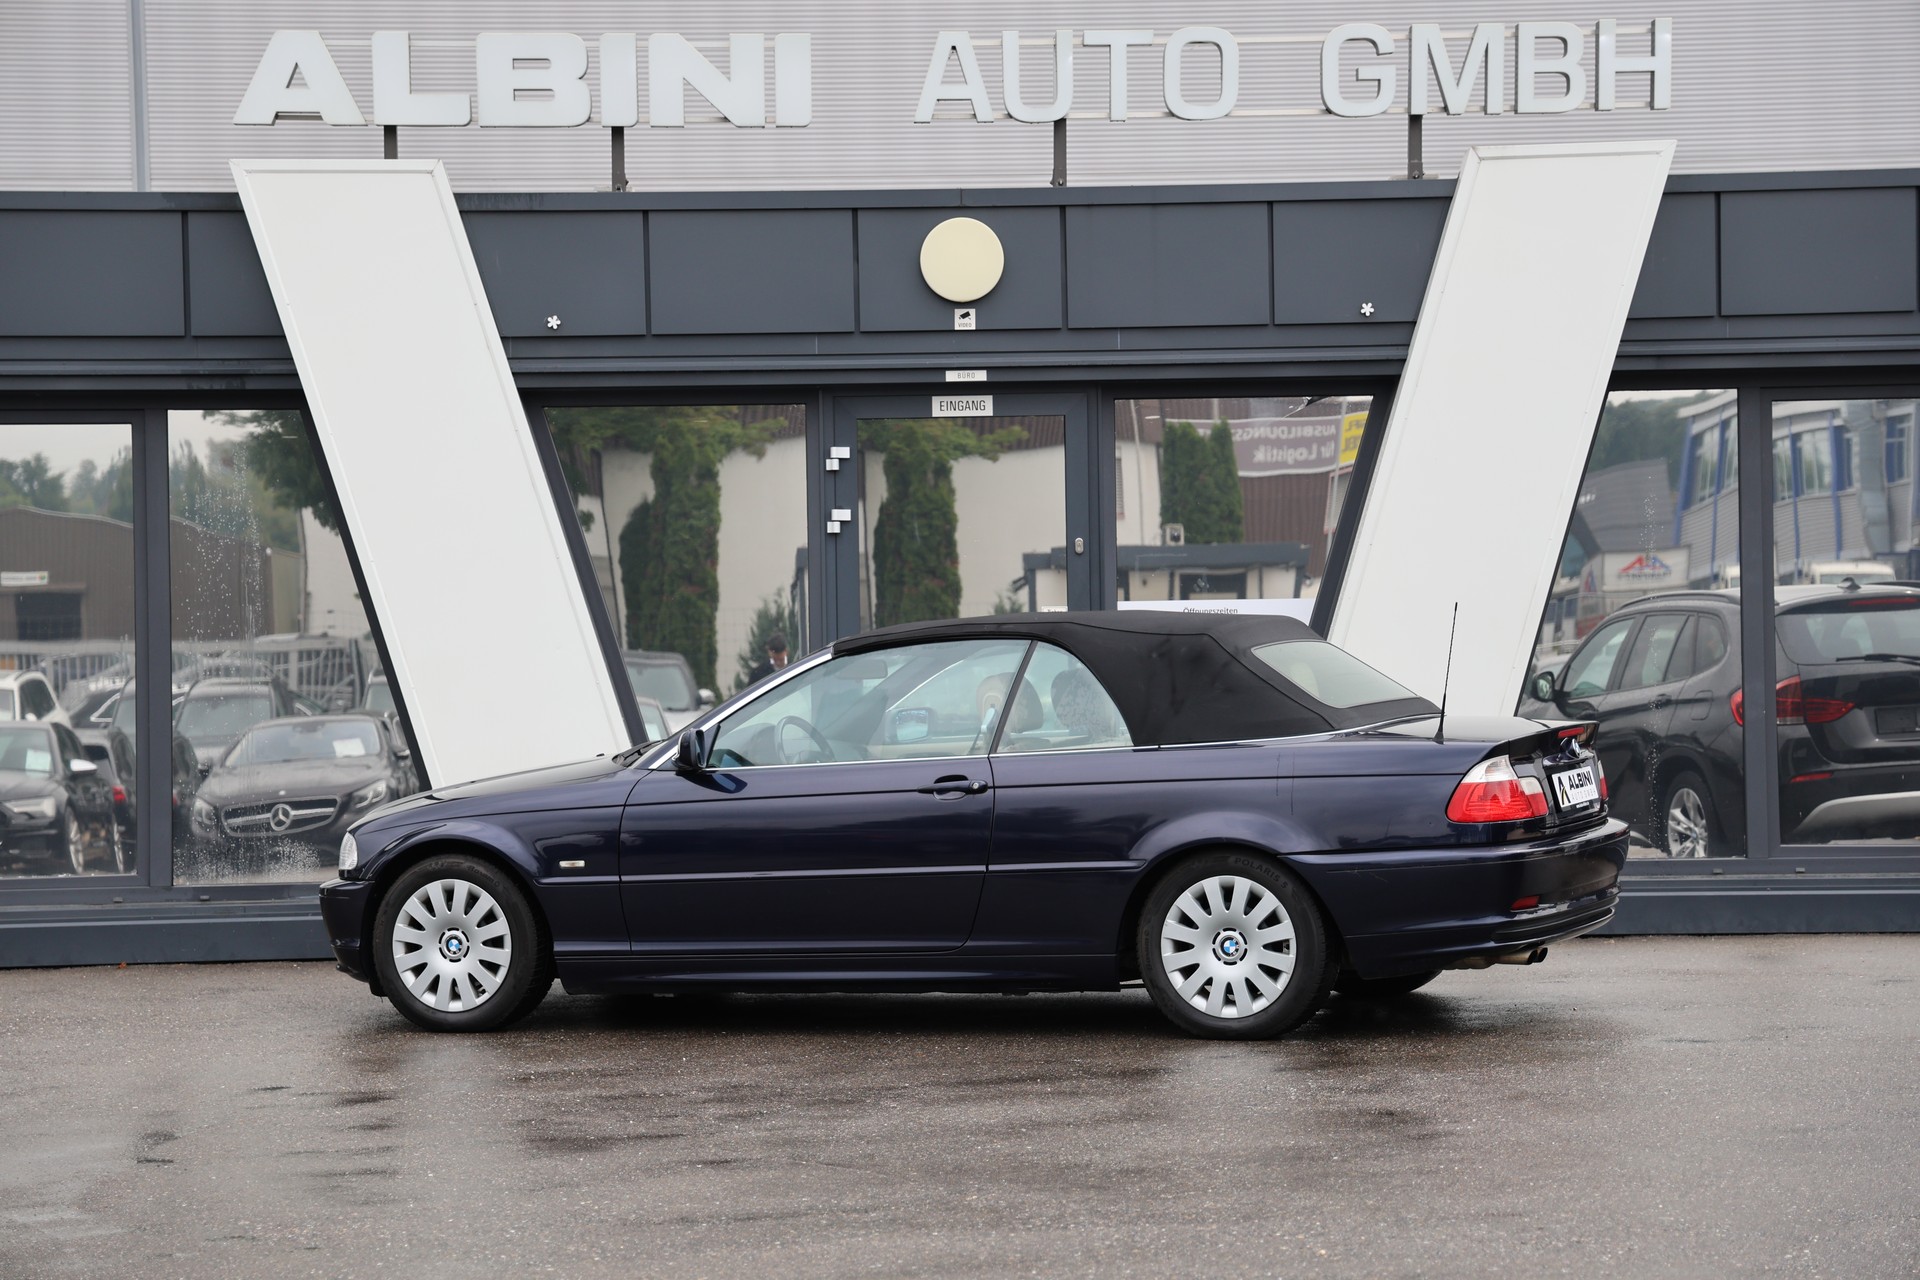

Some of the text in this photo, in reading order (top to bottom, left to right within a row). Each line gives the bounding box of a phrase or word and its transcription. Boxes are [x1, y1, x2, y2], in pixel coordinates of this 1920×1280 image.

[233, 18, 1672, 128] ALBINI AUTO GMBH
[939, 400, 986, 411] EINGANG
[1568, 770, 1593, 790] ALBINI
[1234, 857, 1280, 881] POLARIS
